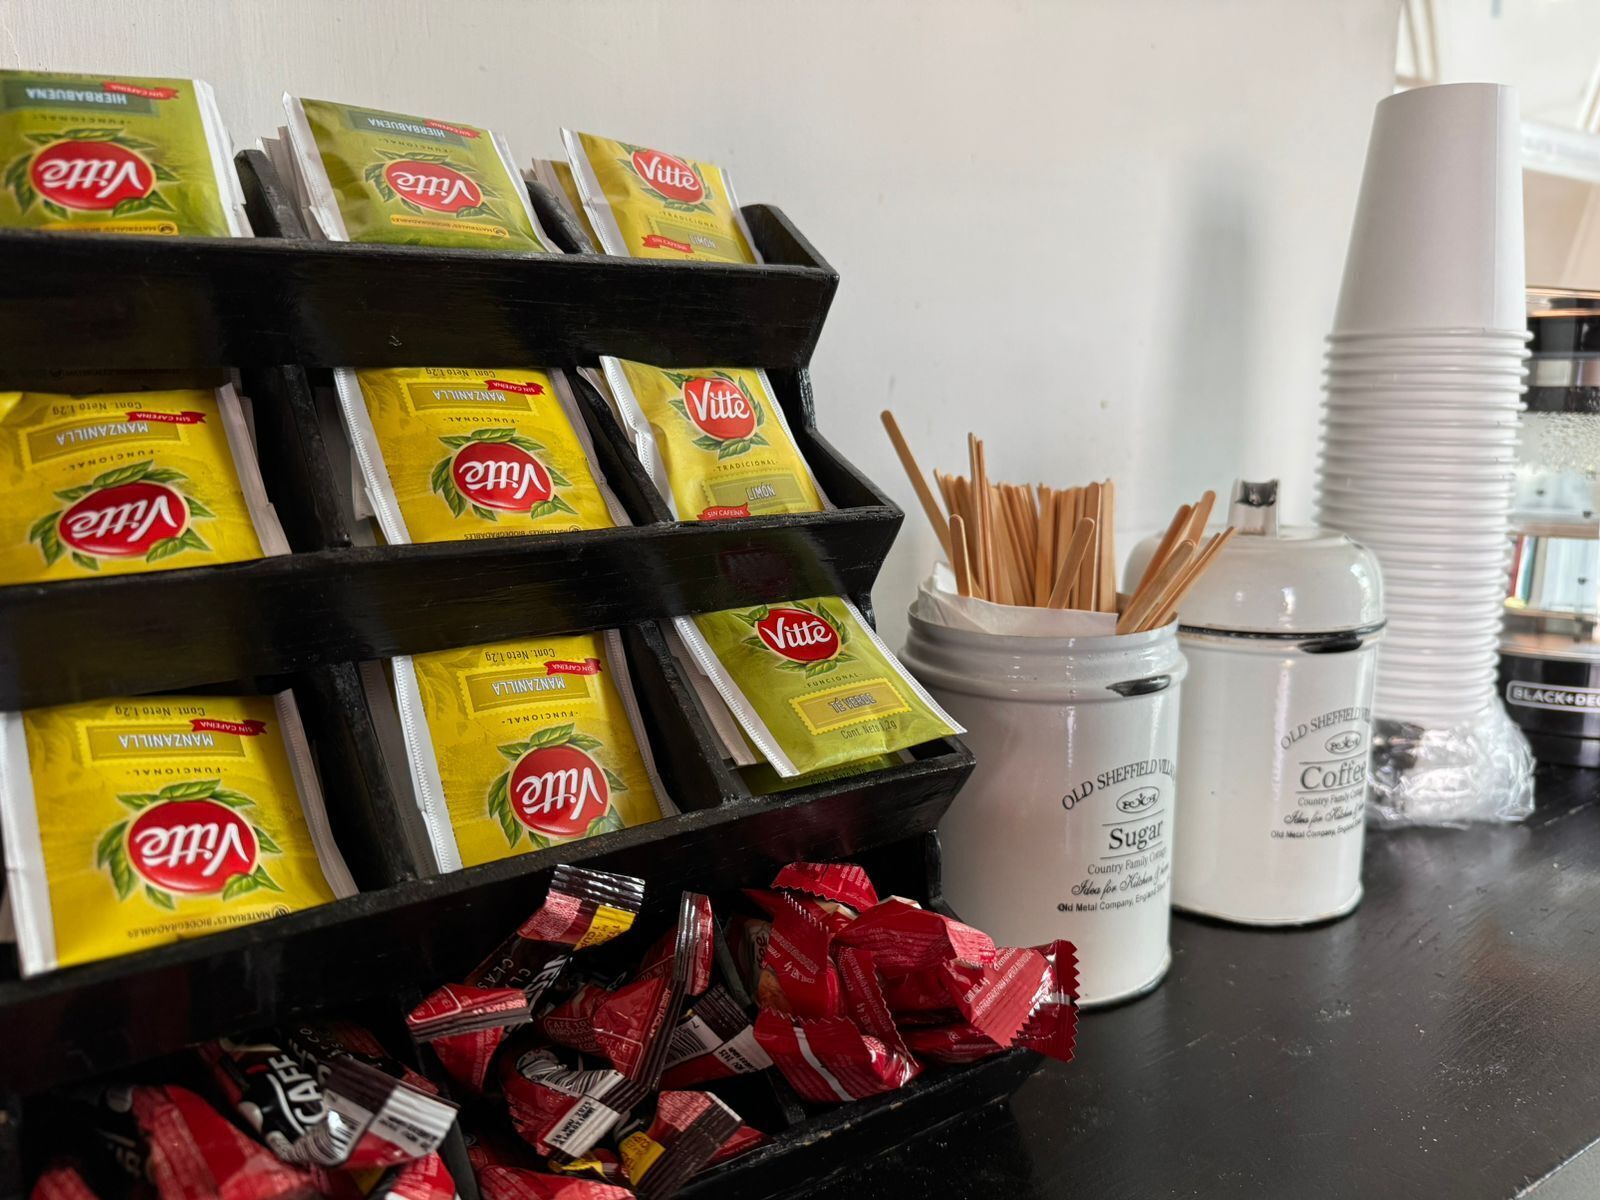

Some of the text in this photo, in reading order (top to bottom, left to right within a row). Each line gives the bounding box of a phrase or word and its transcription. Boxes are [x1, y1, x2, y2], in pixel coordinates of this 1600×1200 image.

[26, 88, 127, 104] HIERBABUENA
[368, 118, 445, 138] HIERBABUENA
[383, 138, 450, 153] FUNCIONAL
[432, 389, 507, 402] MANZANILLA
[449, 416, 516, 424] FUNCIONAL
[56, 422, 149, 446] MANZANILLA
[69, 449, 155, 471] FUNCIONAL
[716, 459, 776, 472] TRADICIONAL
[746, 482, 776, 501] LIMÓN
[485, 648, 556, 663] Cont. Neto 1.2g
[492, 676, 566, 695] MANZANILLA
[807, 672, 859, 689] FUNCIONAL
[142, 706, 171, 717] Neto
[174, 706, 206, 717] Cont.
[507, 710, 574, 724] FUNCIONAL
[118, 734, 215, 748] MANZANILLA
[1280, 723, 1308, 750] OLD
[136, 767, 222, 776] FUNCIONAL
[1062, 780, 1094, 810] OLD
[1096, 759, 1158, 790] SHEFFIELD
[1298, 796, 1330, 807] Country
[1108, 820, 1163, 850] Sugar
[1087, 861, 1124, 876] Country
[1125, 854, 1149, 871] Family
[1100, 878, 1117, 900] for
[1057, 902, 1074, 912] Old
[1075, 900, 1098, 912] Metal
[1099, 896, 1134, 911] Company,
